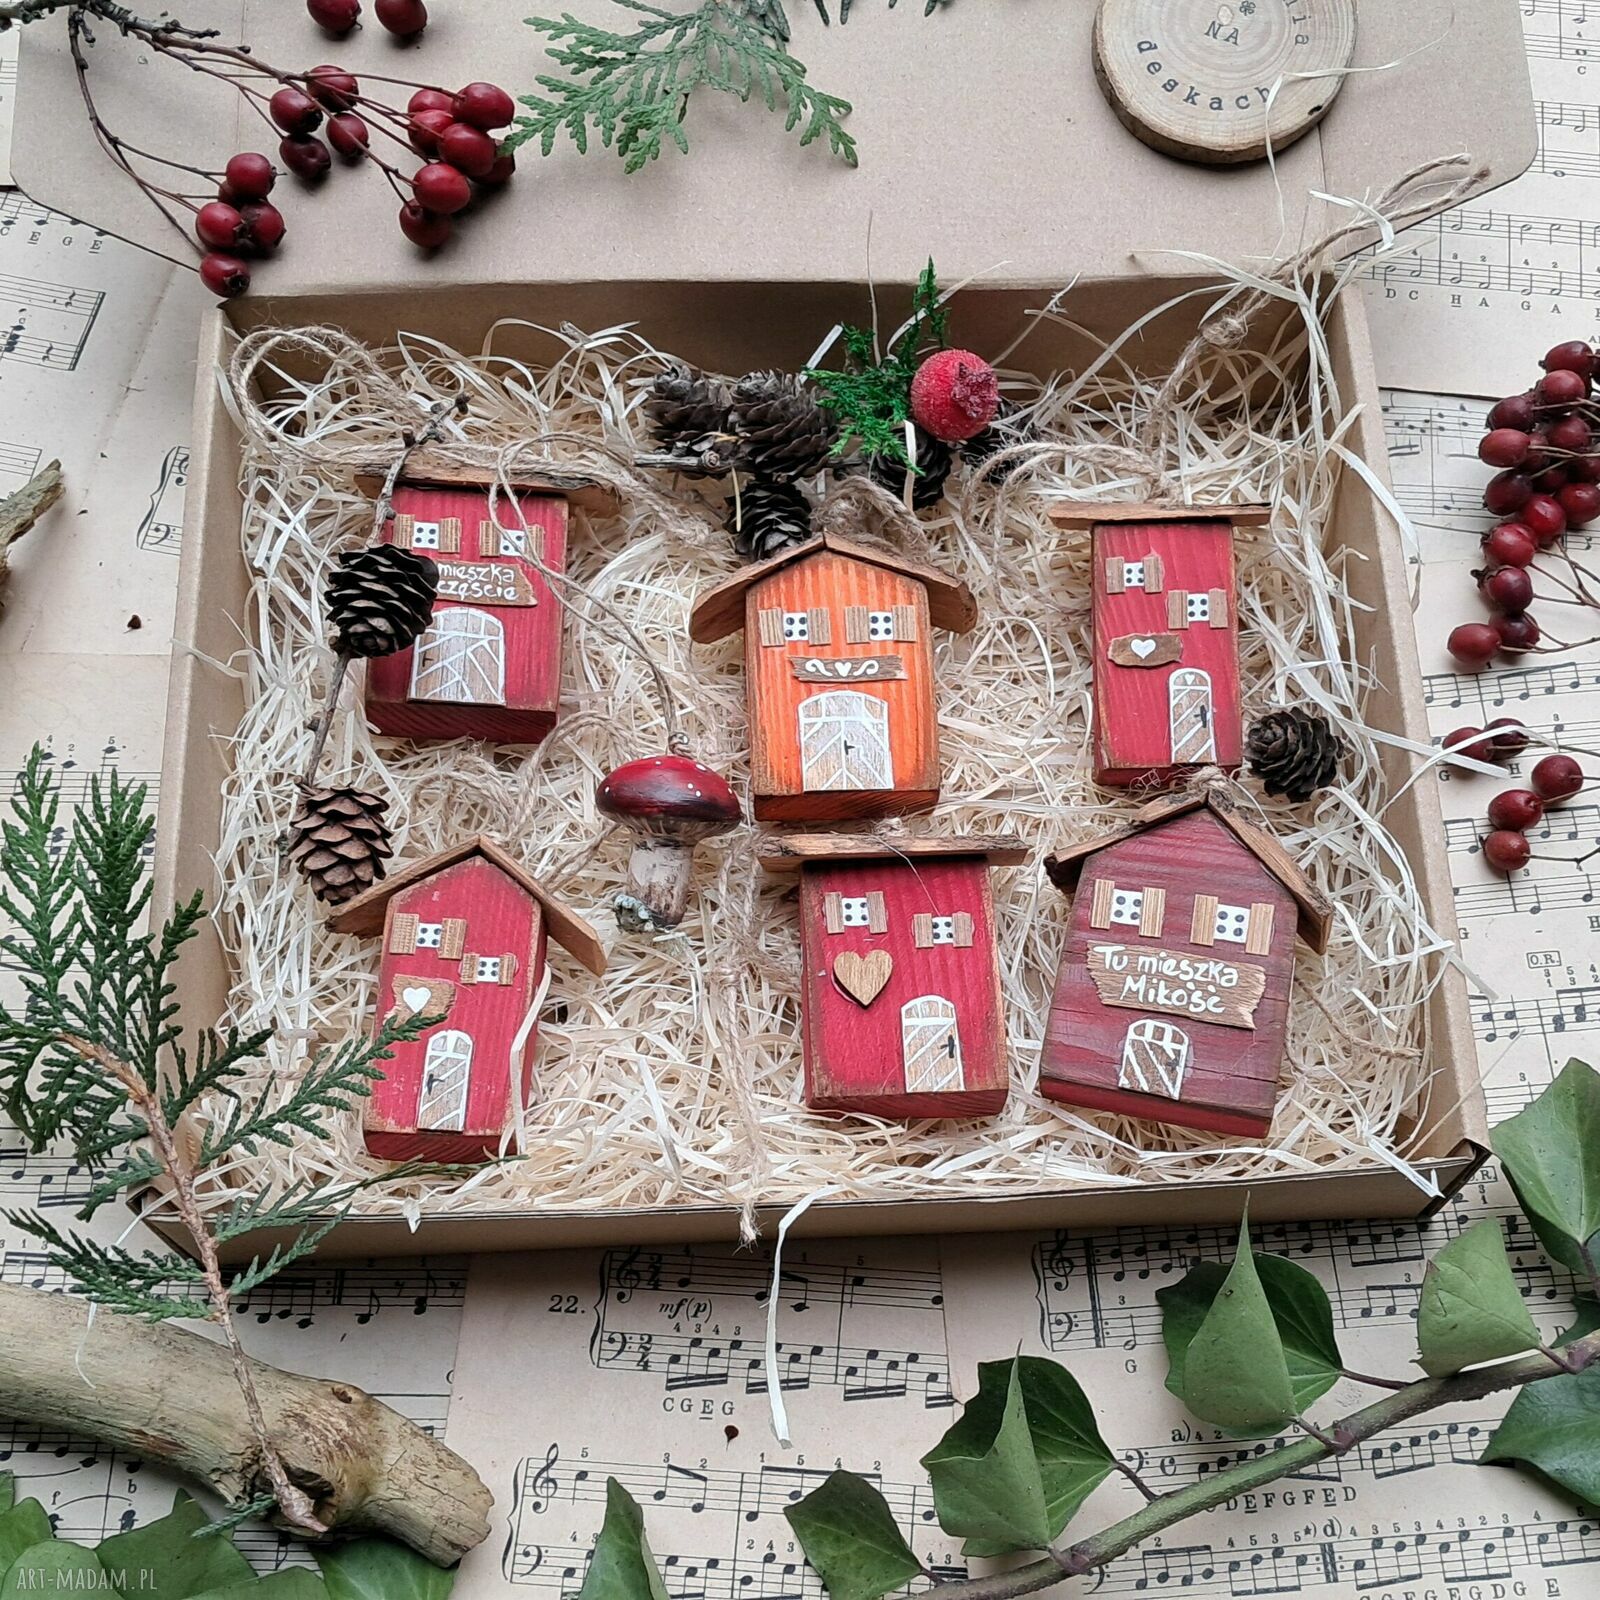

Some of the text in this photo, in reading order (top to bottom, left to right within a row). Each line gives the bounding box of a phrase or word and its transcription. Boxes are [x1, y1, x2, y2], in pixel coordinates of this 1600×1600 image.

[1204, 20, 1240, 46] NA
[1136, 40, 1271, 112] deskach
[1577, 65, 1587, 75] C
[30, 231, 41, 242] E
[62, 236, 73, 246] G
[90, 239, 102, 250] E
[1385, 287, 1562, 314] D C H A G A
[437, 561, 515, 583] mieszka
[1439, 763, 1521, 782] G H
[1093, 945, 1239, 988] Tu mieszka
[1529, 953, 1561, 966] O.R.
[1119, 973, 1226, 1014] Miłość
[548, 1294, 586, 1314] 22.
[1125, 1359, 1138, 1373] G
[662, 1397, 735, 1416] C G E G
[1171, 1419, 1192, 1443] a)
[1243, 1494, 1257, 1510] E
[1262, 1492, 1276, 1508] F
[1283, 1491, 1296, 1506] G
[1303, 1490, 1316, 1505] F
[1322, 1488, 1336, 1503] E
[1343, 1486, 1357, 1502] D
[1323, 1516, 1342, 1539] d)
[1469, 1585, 1482, 1600] G
[1491, 1583, 1506, 1599] D
[1513, 1581, 1527, 1596] G
[1545, 1578, 1560, 1594] E
